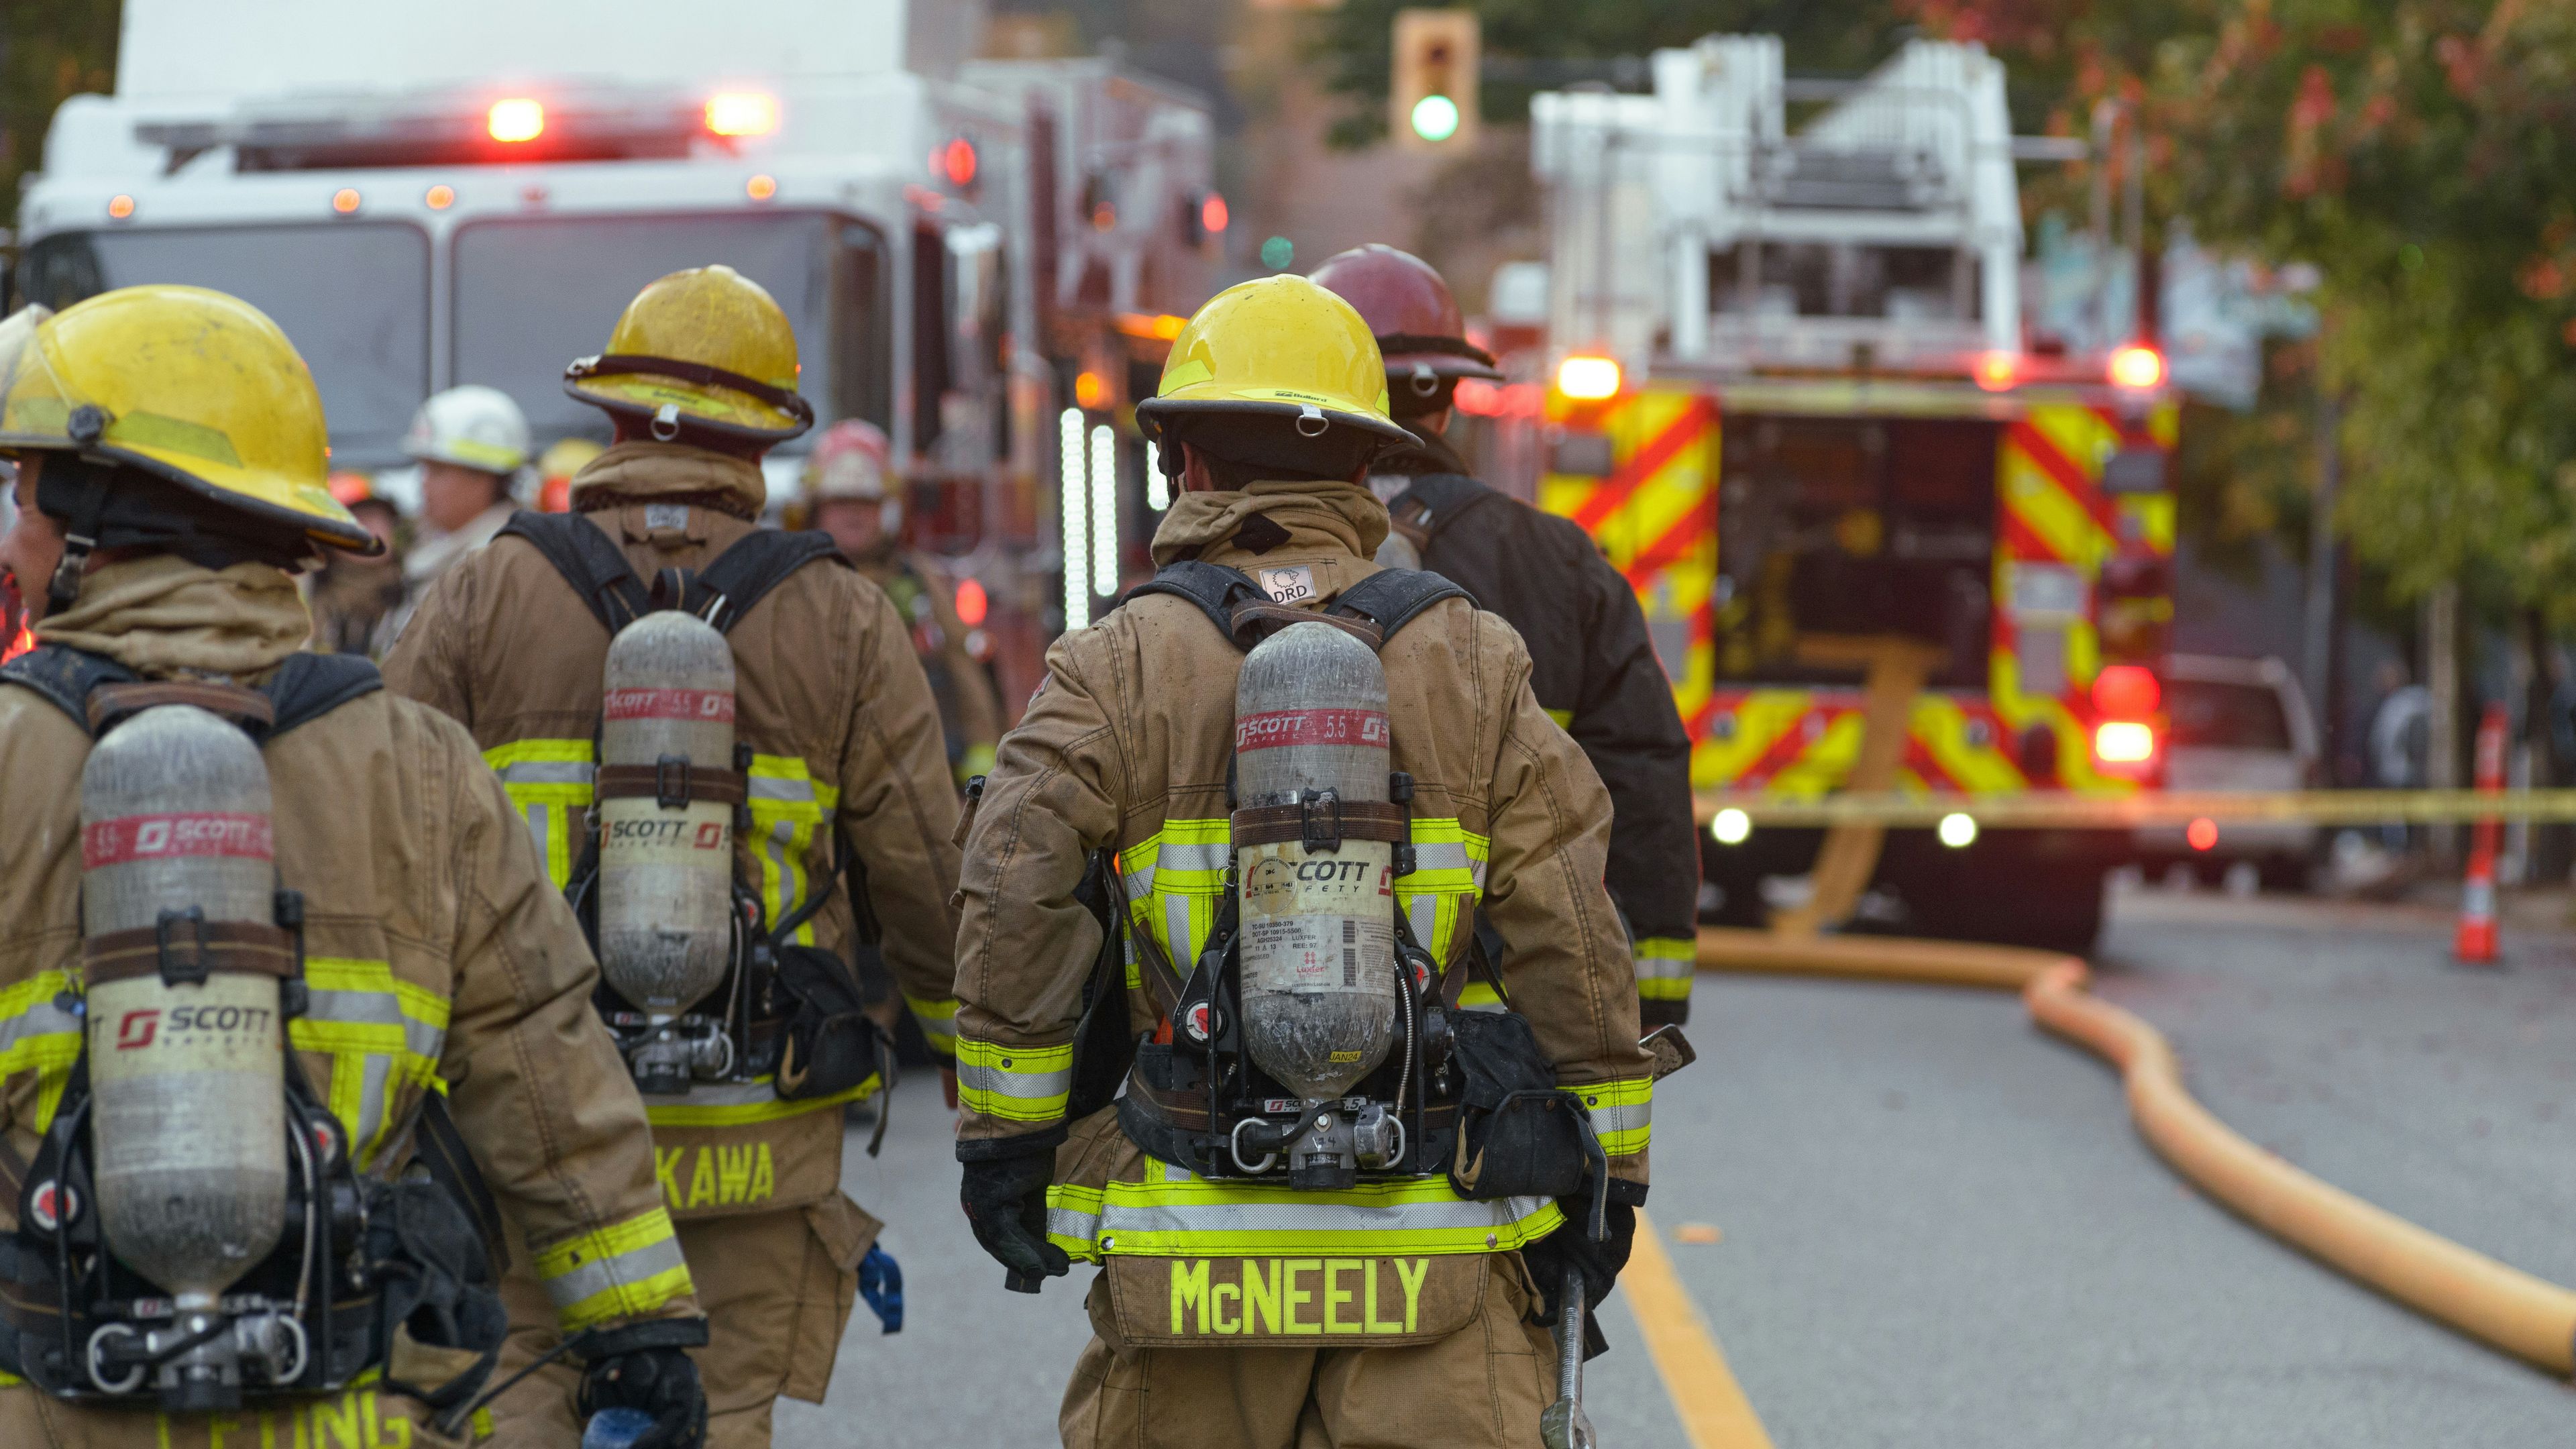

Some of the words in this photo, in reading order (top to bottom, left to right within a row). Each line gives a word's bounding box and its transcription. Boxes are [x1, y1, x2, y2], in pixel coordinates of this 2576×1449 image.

[1293, 393, 1327, 402] Bullard
[1274, 586, 1307, 603] DRD
[1248, 716, 1307, 736] SCOTT
[1326, 715, 1346, 738] 5.5
[176, 818, 251, 850] SCOTT
[613, 820, 688, 839] SCOTT
[1288, 860, 1370, 881] COTT
[1305, 885, 1359, 893] FETY
[1252, 930, 1269, 938] DOT-SP
[1271, 928, 1301, 936] 10915-5500
[168, 1006, 270, 1033] SCOTT
[1331, 1052, 1358, 1061] JAN24
[654, 1142, 775, 1210] KAWA
[1171, 1258, 1430, 1334] McNEELY
